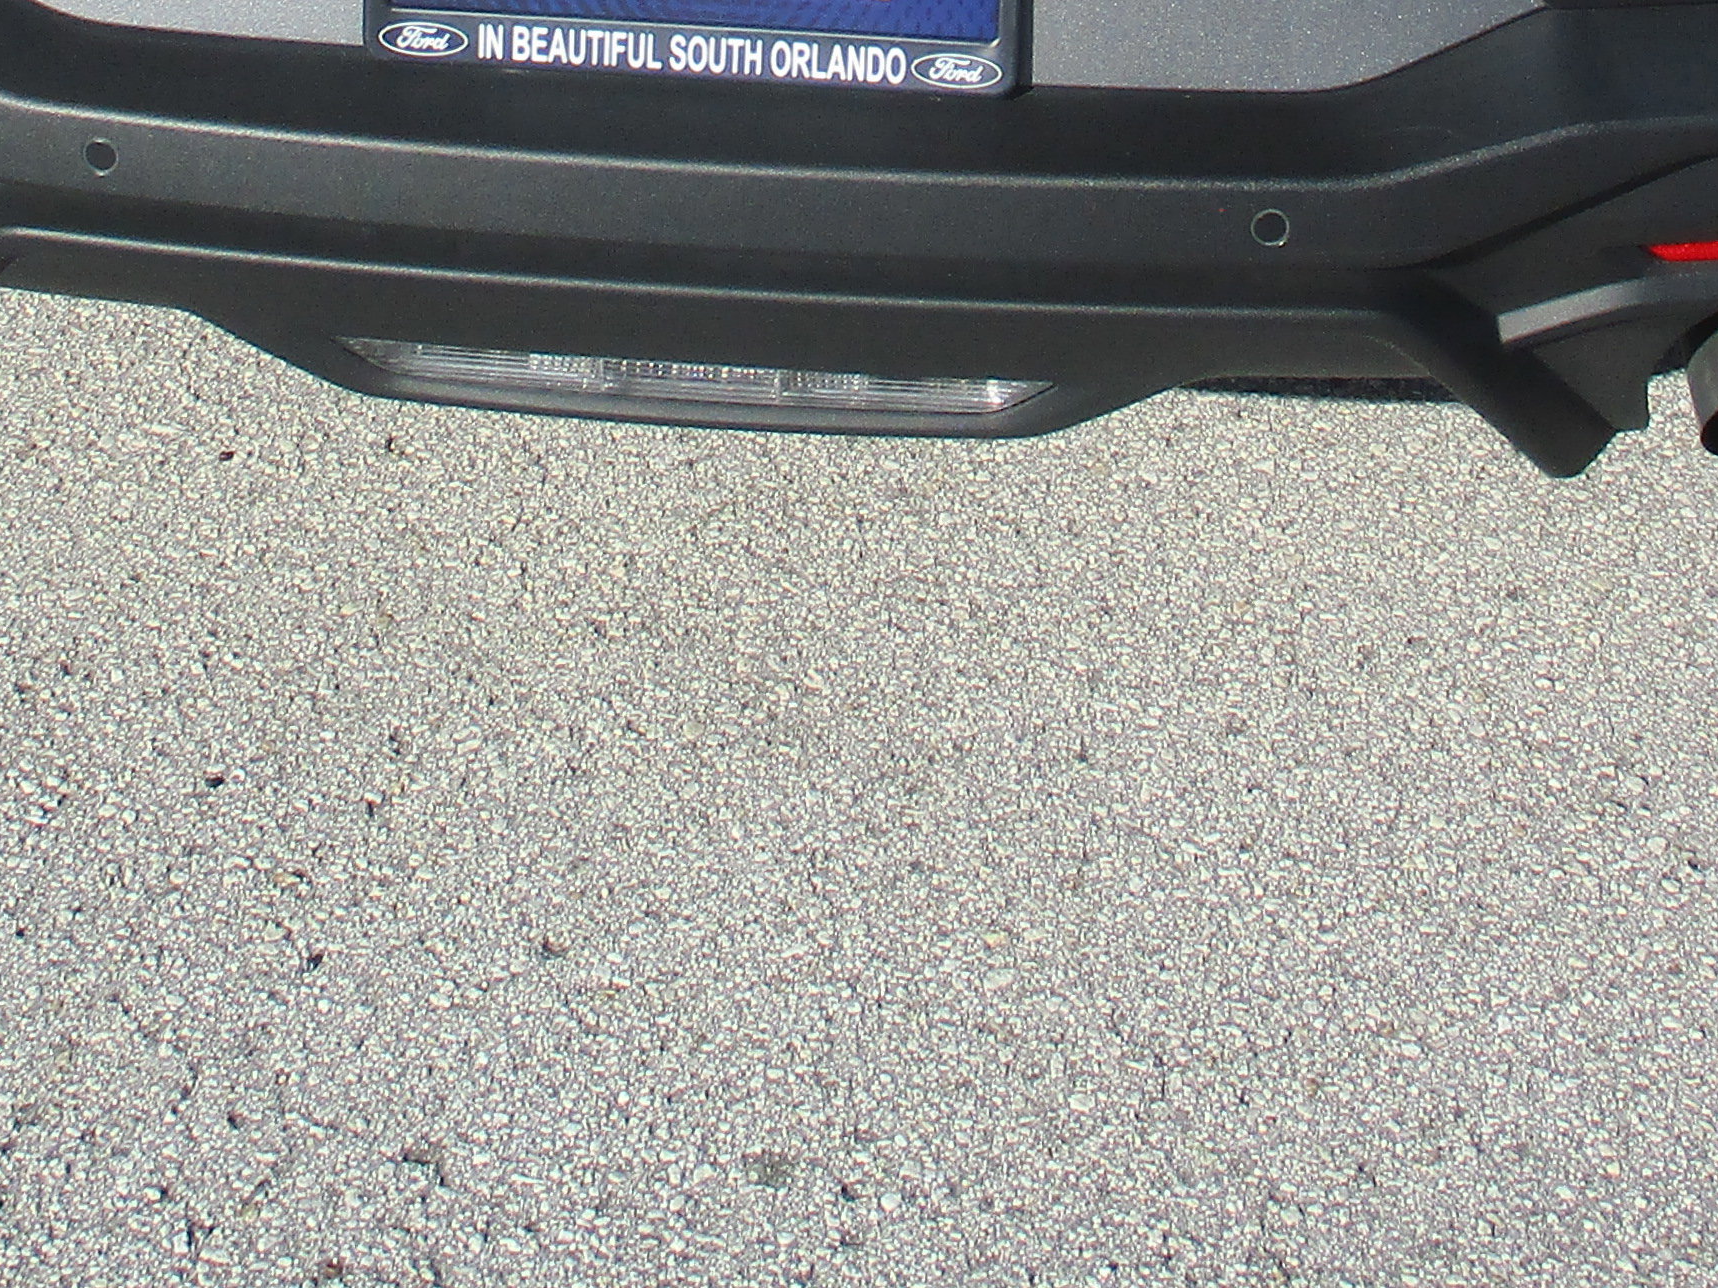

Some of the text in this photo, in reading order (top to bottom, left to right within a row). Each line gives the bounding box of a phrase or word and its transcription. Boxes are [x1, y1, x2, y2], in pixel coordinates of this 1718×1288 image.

[396, 26, 450, 52] Ford
[478, 24, 906, 84] IN BEAUTIFUL SOUTH ORLANDO
[929, 57, 983, 83] Ford
